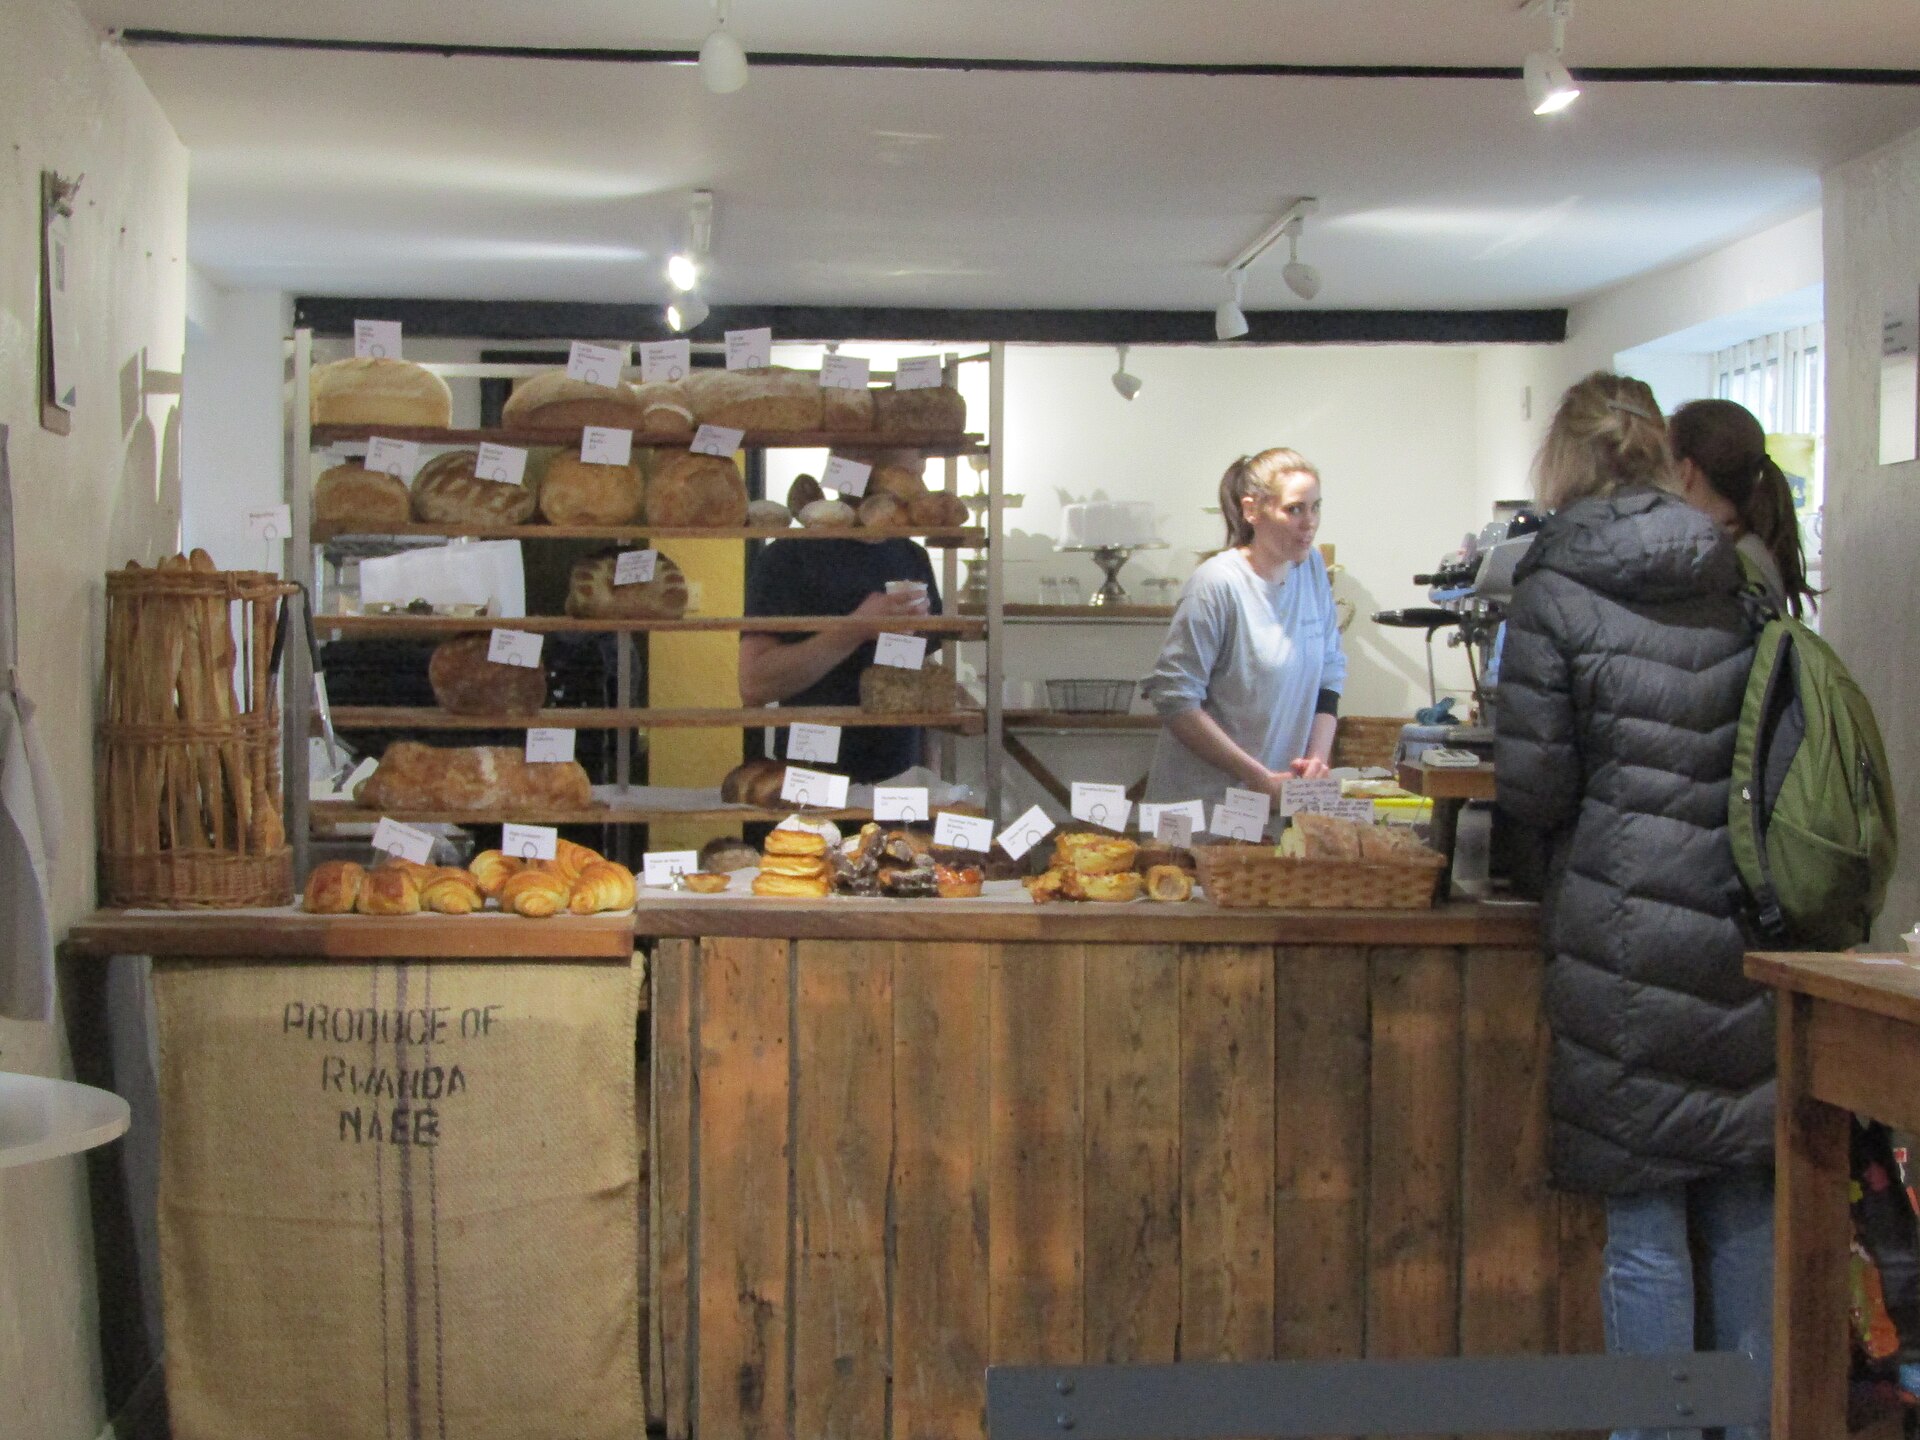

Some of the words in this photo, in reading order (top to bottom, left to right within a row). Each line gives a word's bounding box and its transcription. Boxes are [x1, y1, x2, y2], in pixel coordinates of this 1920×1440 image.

[283, 1001, 451, 1045] PRODUCE
[461, 1004, 504, 1039] OF
[321, 1055, 467, 1099] RWANDA
